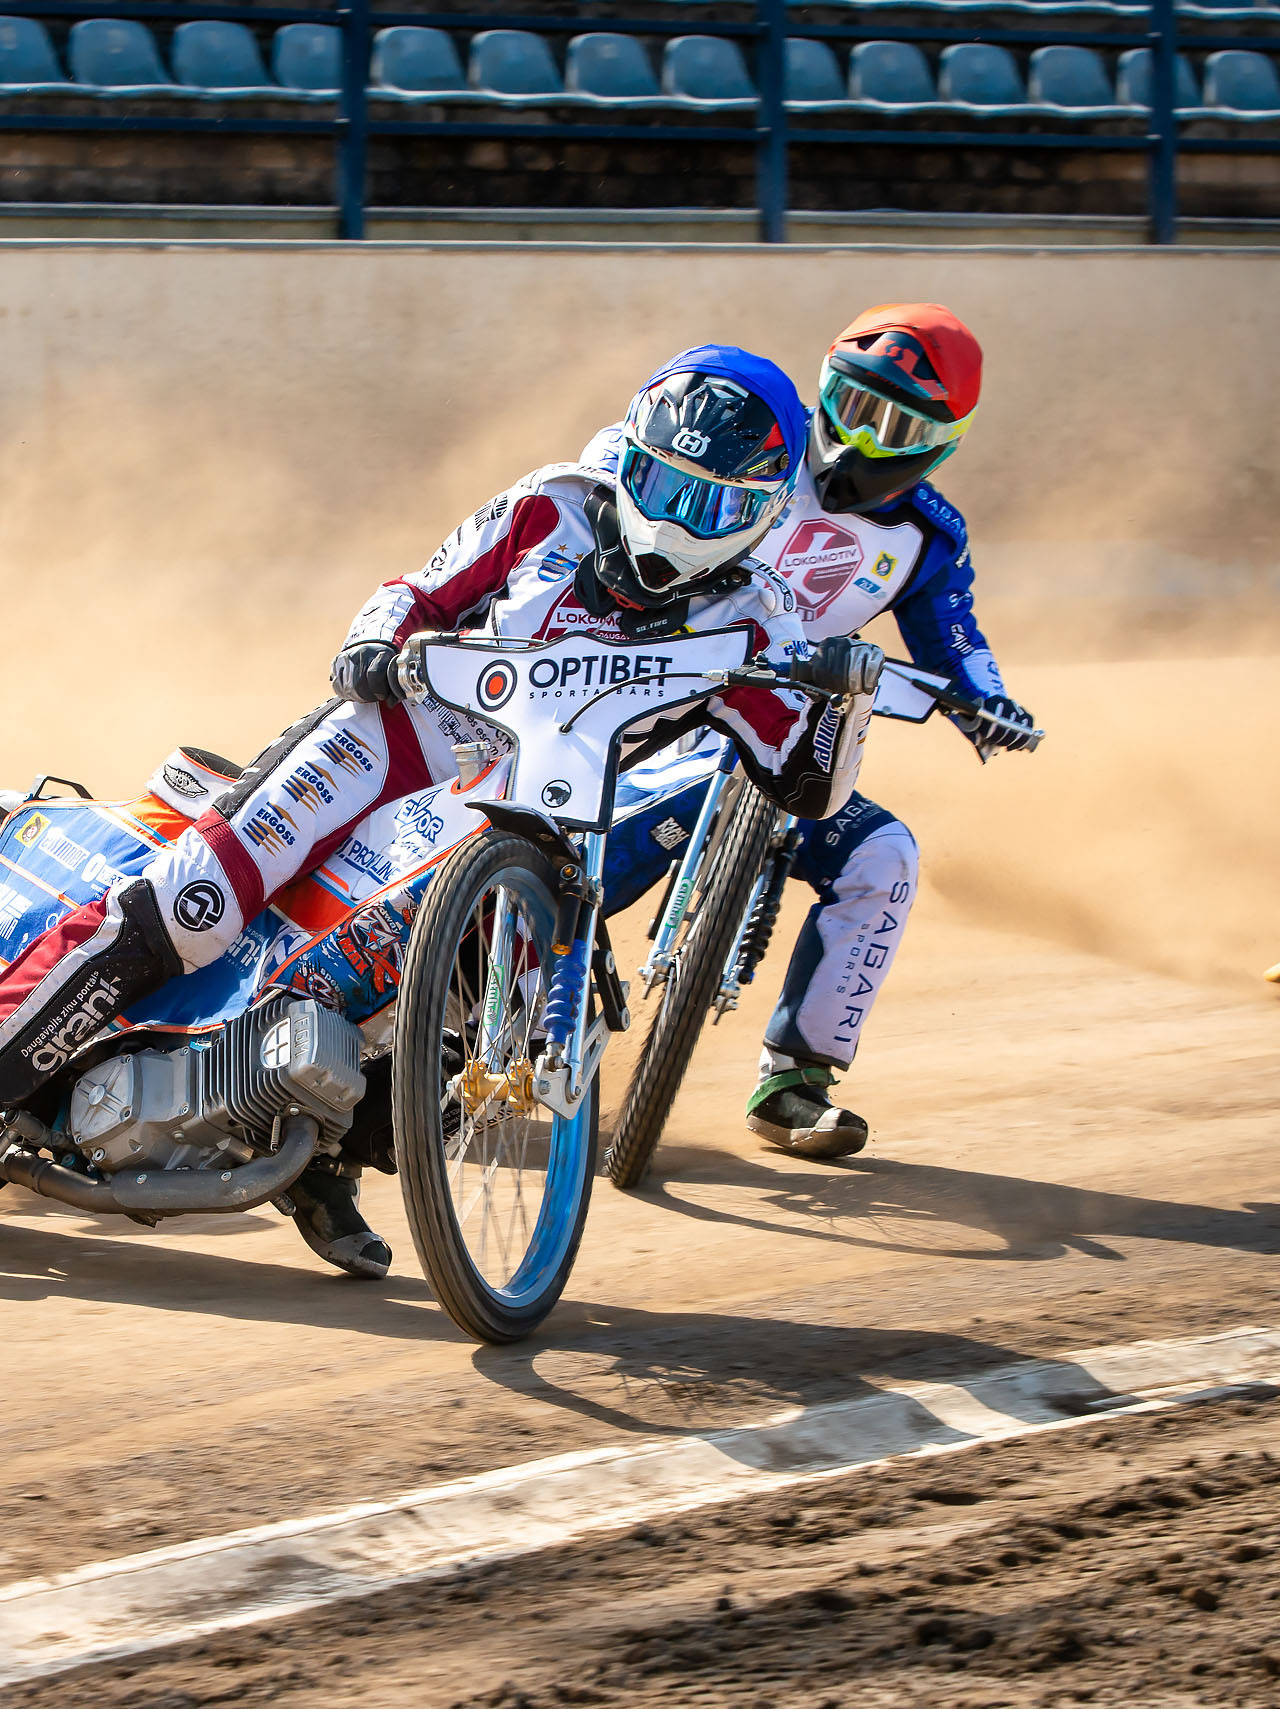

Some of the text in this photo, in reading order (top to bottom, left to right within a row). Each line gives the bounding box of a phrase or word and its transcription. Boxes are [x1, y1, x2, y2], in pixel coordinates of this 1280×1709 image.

[784, 548, 857, 567] LOKOMOTIV
[529, 654, 673, 689] OPTIBET
[529, 689, 601, 699] SPORTA
[334, 733, 373, 772] ERGOSS
[295, 767, 334, 804] ERGOSS
[255, 808, 296, 846] ERGOSS
[395, 798, 444, 844] EVOR
[834, 881, 910, 1043] SAGARI
[836, 922, 872, 995] SPORTS
[21, 969, 100, 1059] Daugavpils ziņu portāls
